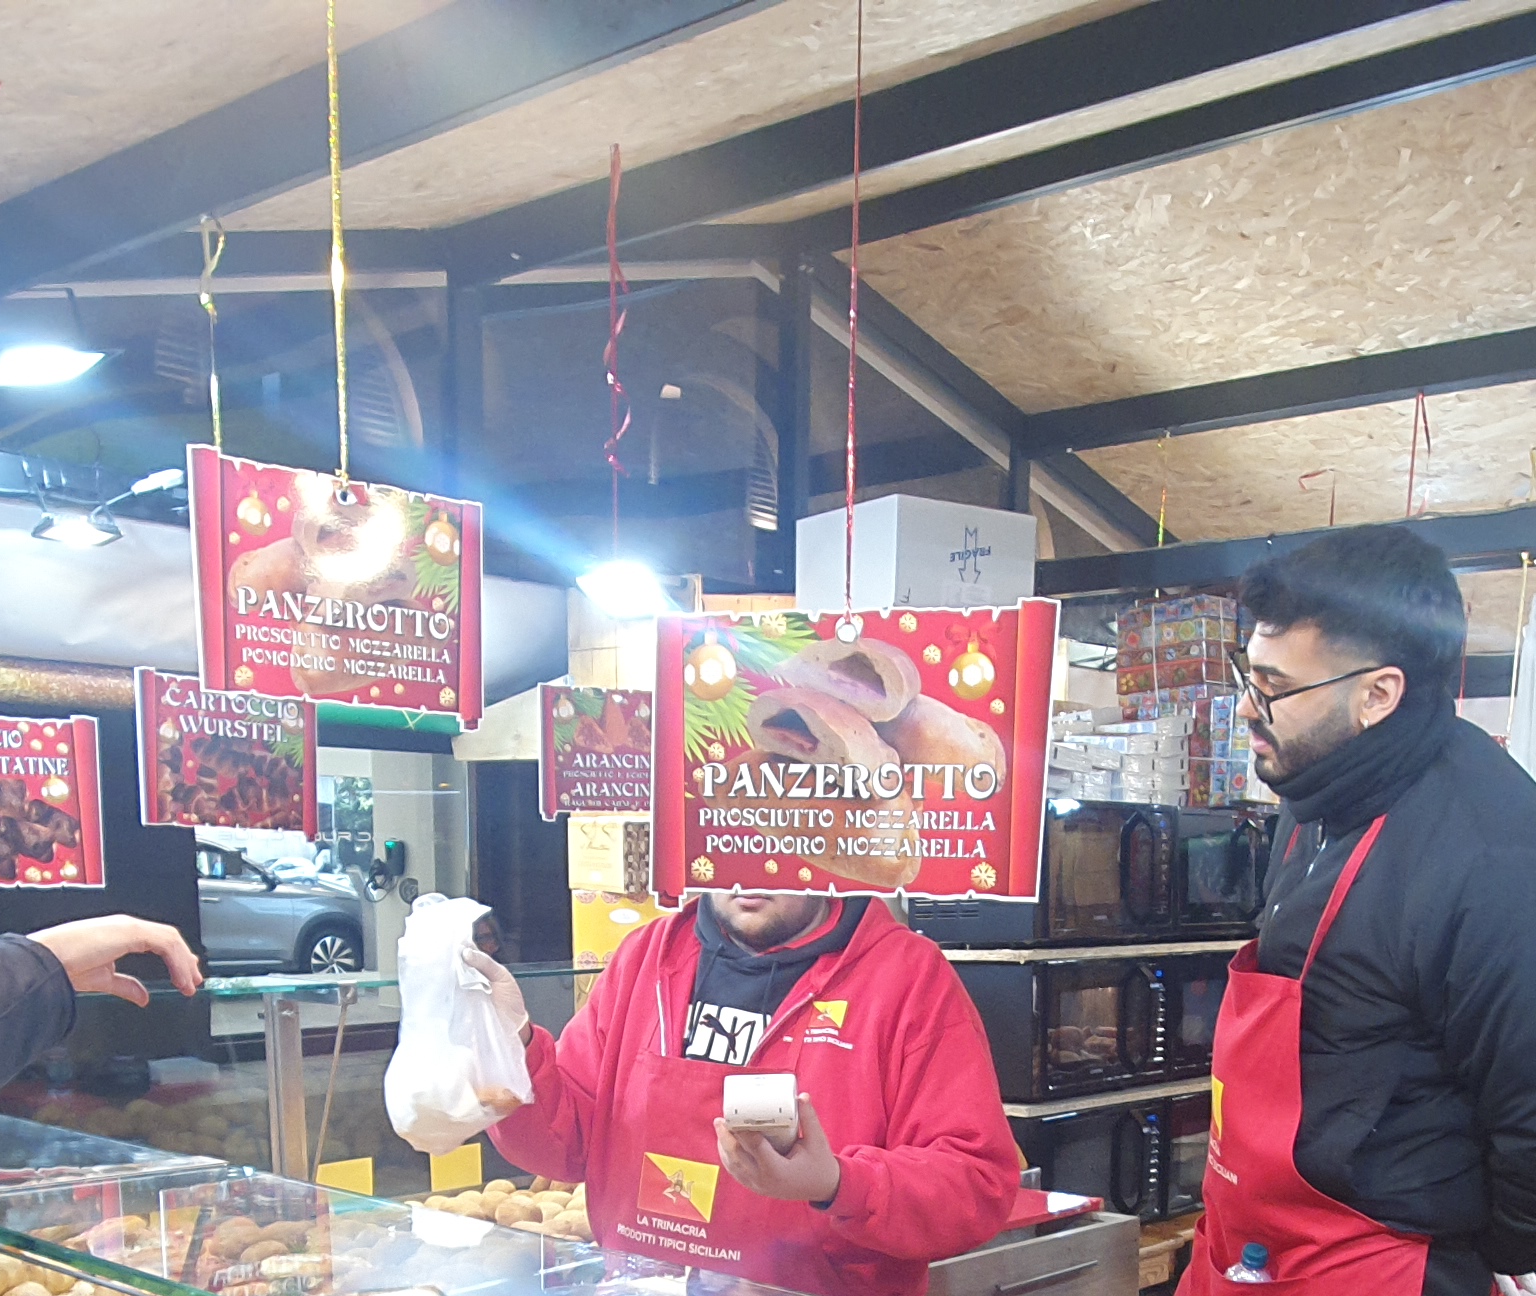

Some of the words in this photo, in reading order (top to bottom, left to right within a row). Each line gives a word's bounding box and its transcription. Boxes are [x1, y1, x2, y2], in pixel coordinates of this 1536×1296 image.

[950, 545, 991, 562] FRAGILE
[236, 586, 451, 641] PANZEROTTO
[235, 623, 341, 651] PROSCIUTTO
[348, 637, 452, 664] MOZZARELLA
[242, 646, 336, 671] POMODORO
[343, 657, 446, 684] MOZZARELLA
[166, 687, 299, 720] CARTOCCIO
[179, 714, 287, 743] WURSTEL
[572, 753, 651, 769] ARANCIN
[572, 781, 651, 797] ARANCIN
[702, 762, 997, 800] PANZEROTTO
[698, 807, 834, 828] PROSCIUTTO
[845, 809, 996, 831] MOZZARELLA
[706, 834, 826, 855] POMODORO
[836, 836, 986, 858] MOZZARELLA
[636, 1214, 649, 1227] LA
[651, 1217, 707, 1239] TRINACRIA
[617, 1223, 656, 1245] PRODOTTI
[658, 1236, 686, 1252] TIPICI
[689, 1243, 741, 1261] SICILIANI
